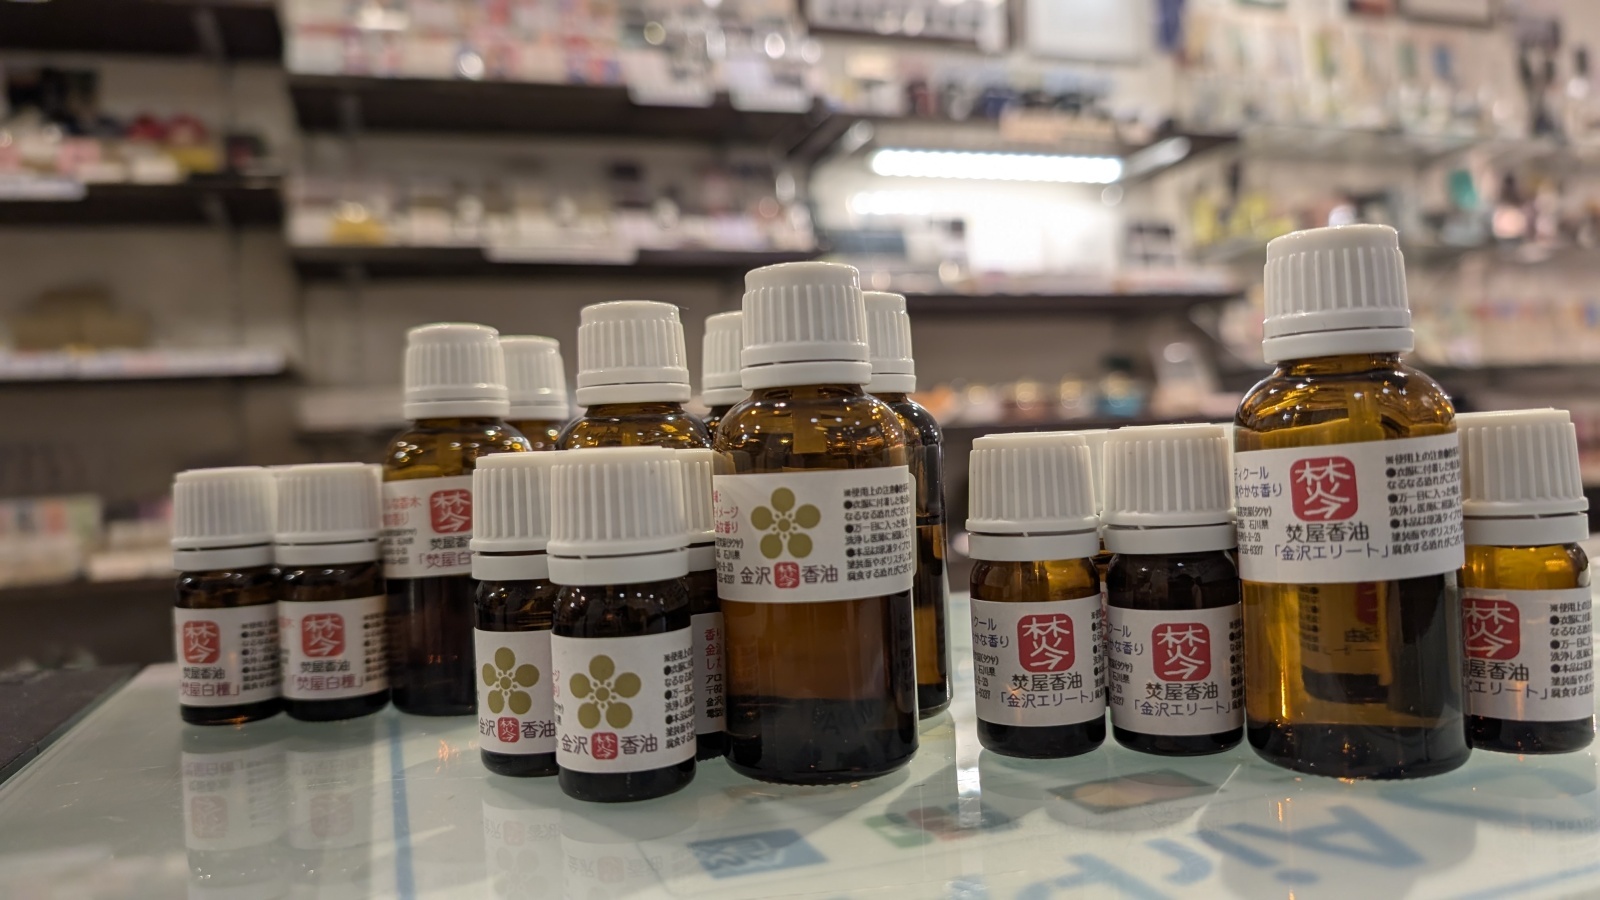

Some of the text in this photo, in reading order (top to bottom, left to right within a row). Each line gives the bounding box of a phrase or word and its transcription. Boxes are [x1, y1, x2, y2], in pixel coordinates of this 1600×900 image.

[1285, 522, 1370, 544] 焚屋香油
[1274, 542, 1389, 561] 「金沢エリート」
[740, 566, 771, 585] 金沢
[802, 565, 838, 584] 香油
[1011, 672, 1082, 692] 焚屋香油
[1145, 681, 1218, 701] 焚屋香油
[1001, 691, 1094, 709] 「金沢エリート」
[1134, 699, 1231, 717] 「金沢エリート」
[561, 732, 589, 756] 金沢
[620, 734, 658, 756] 香油
